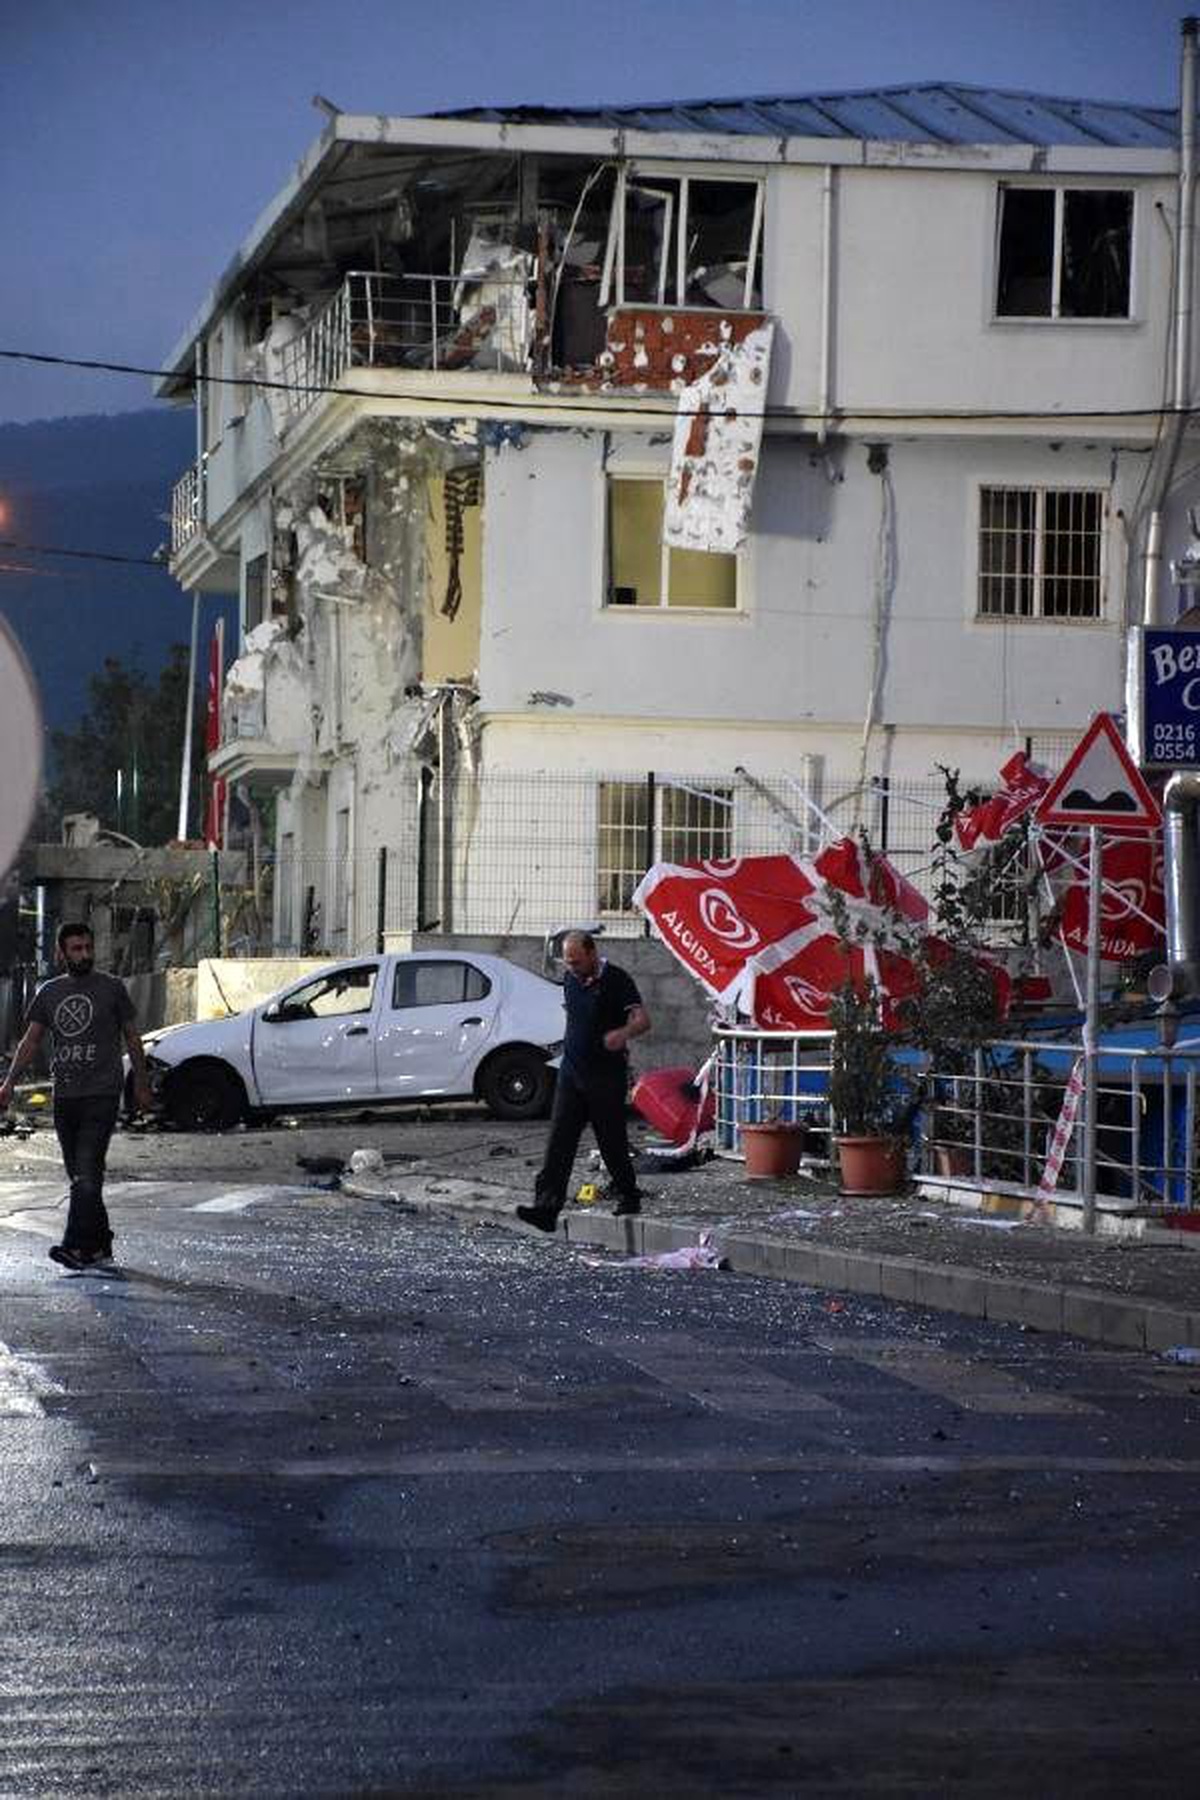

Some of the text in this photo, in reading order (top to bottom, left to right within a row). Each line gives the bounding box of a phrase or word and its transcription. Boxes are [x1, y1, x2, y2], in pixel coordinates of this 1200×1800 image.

[1153, 723, 1195, 741] 0216
[1153, 742, 1196, 760] 0554
[661, 911, 716, 976] ALGIDA
[55, 1044, 97, 1062] ORE
